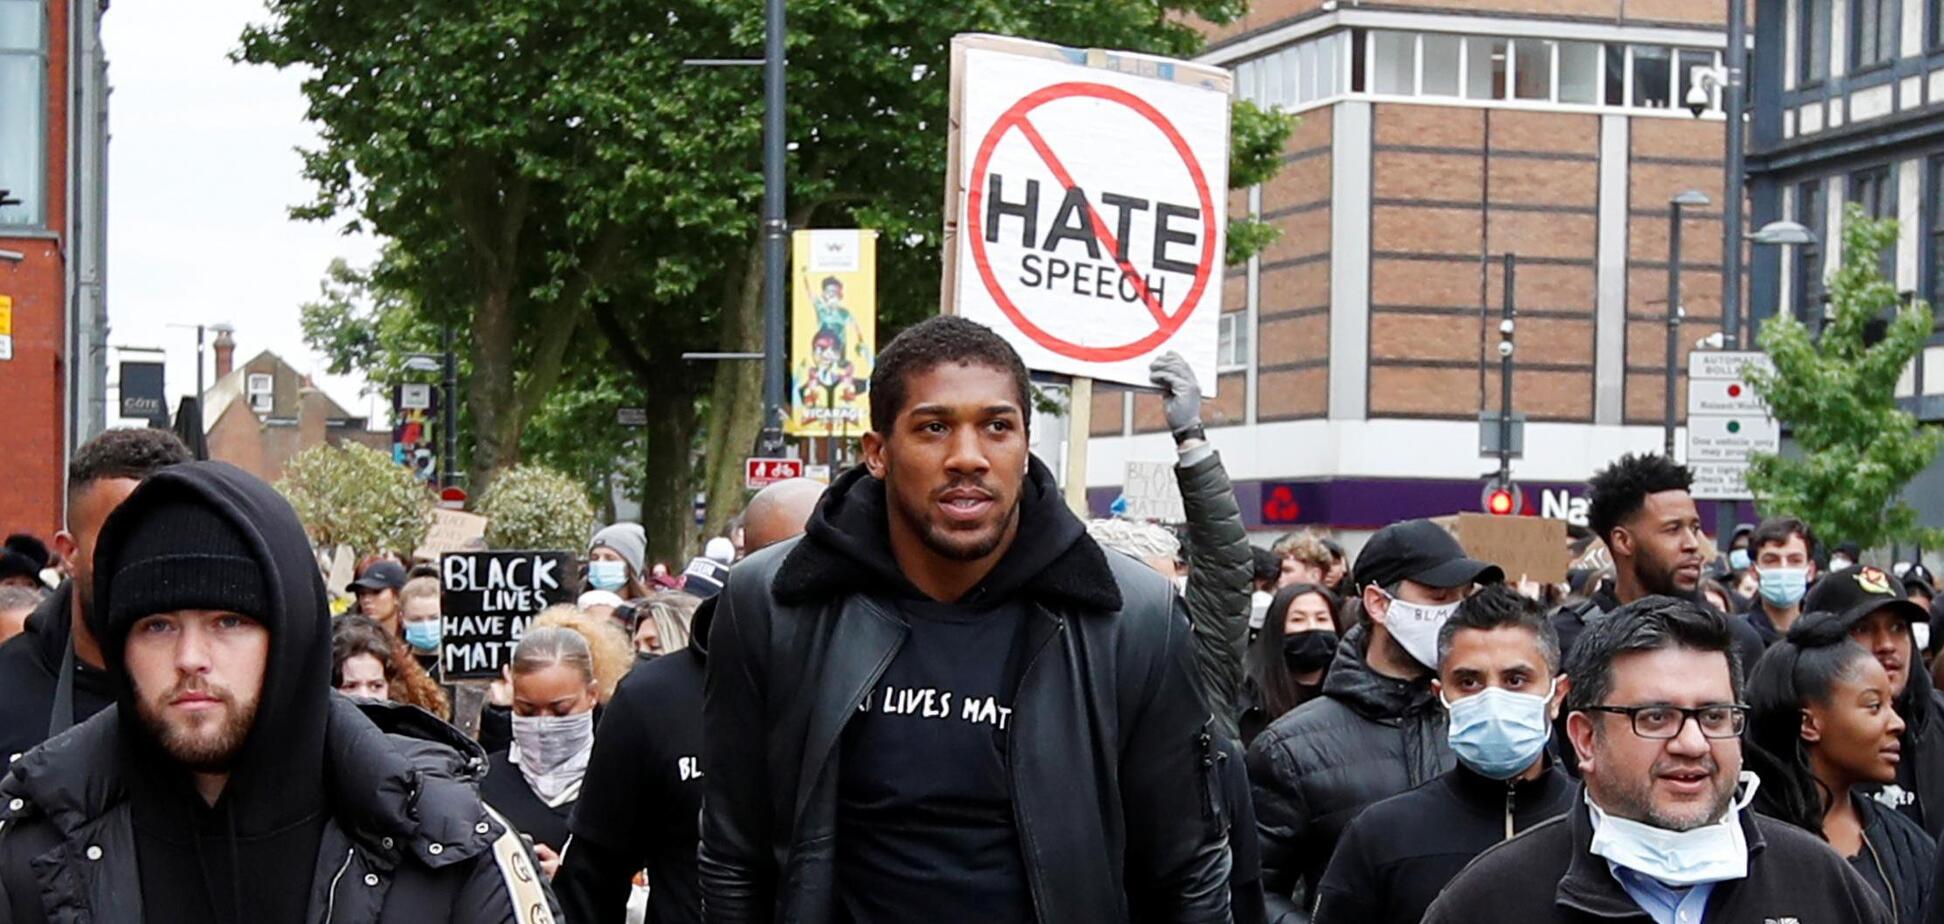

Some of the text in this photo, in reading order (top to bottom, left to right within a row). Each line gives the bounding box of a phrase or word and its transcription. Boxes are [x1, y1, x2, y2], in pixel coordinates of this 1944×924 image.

[985, 173, 1200, 276] HATE
[1019, 254, 1165, 308] SPEECH
[1541, 489, 1593, 527] Na
[444, 555, 559, 592] BLACK
[482, 589, 548, 612] LIVES
[1415, 608, 1448, 621] BLM
[442, 616, 505, 636] HAVE
[445, 641, 520, 673] MATT
[883, 686, 951, 718] LIVES
[962, 696, 1012, 730] MAT
[678, 756, 704, 781] BL
